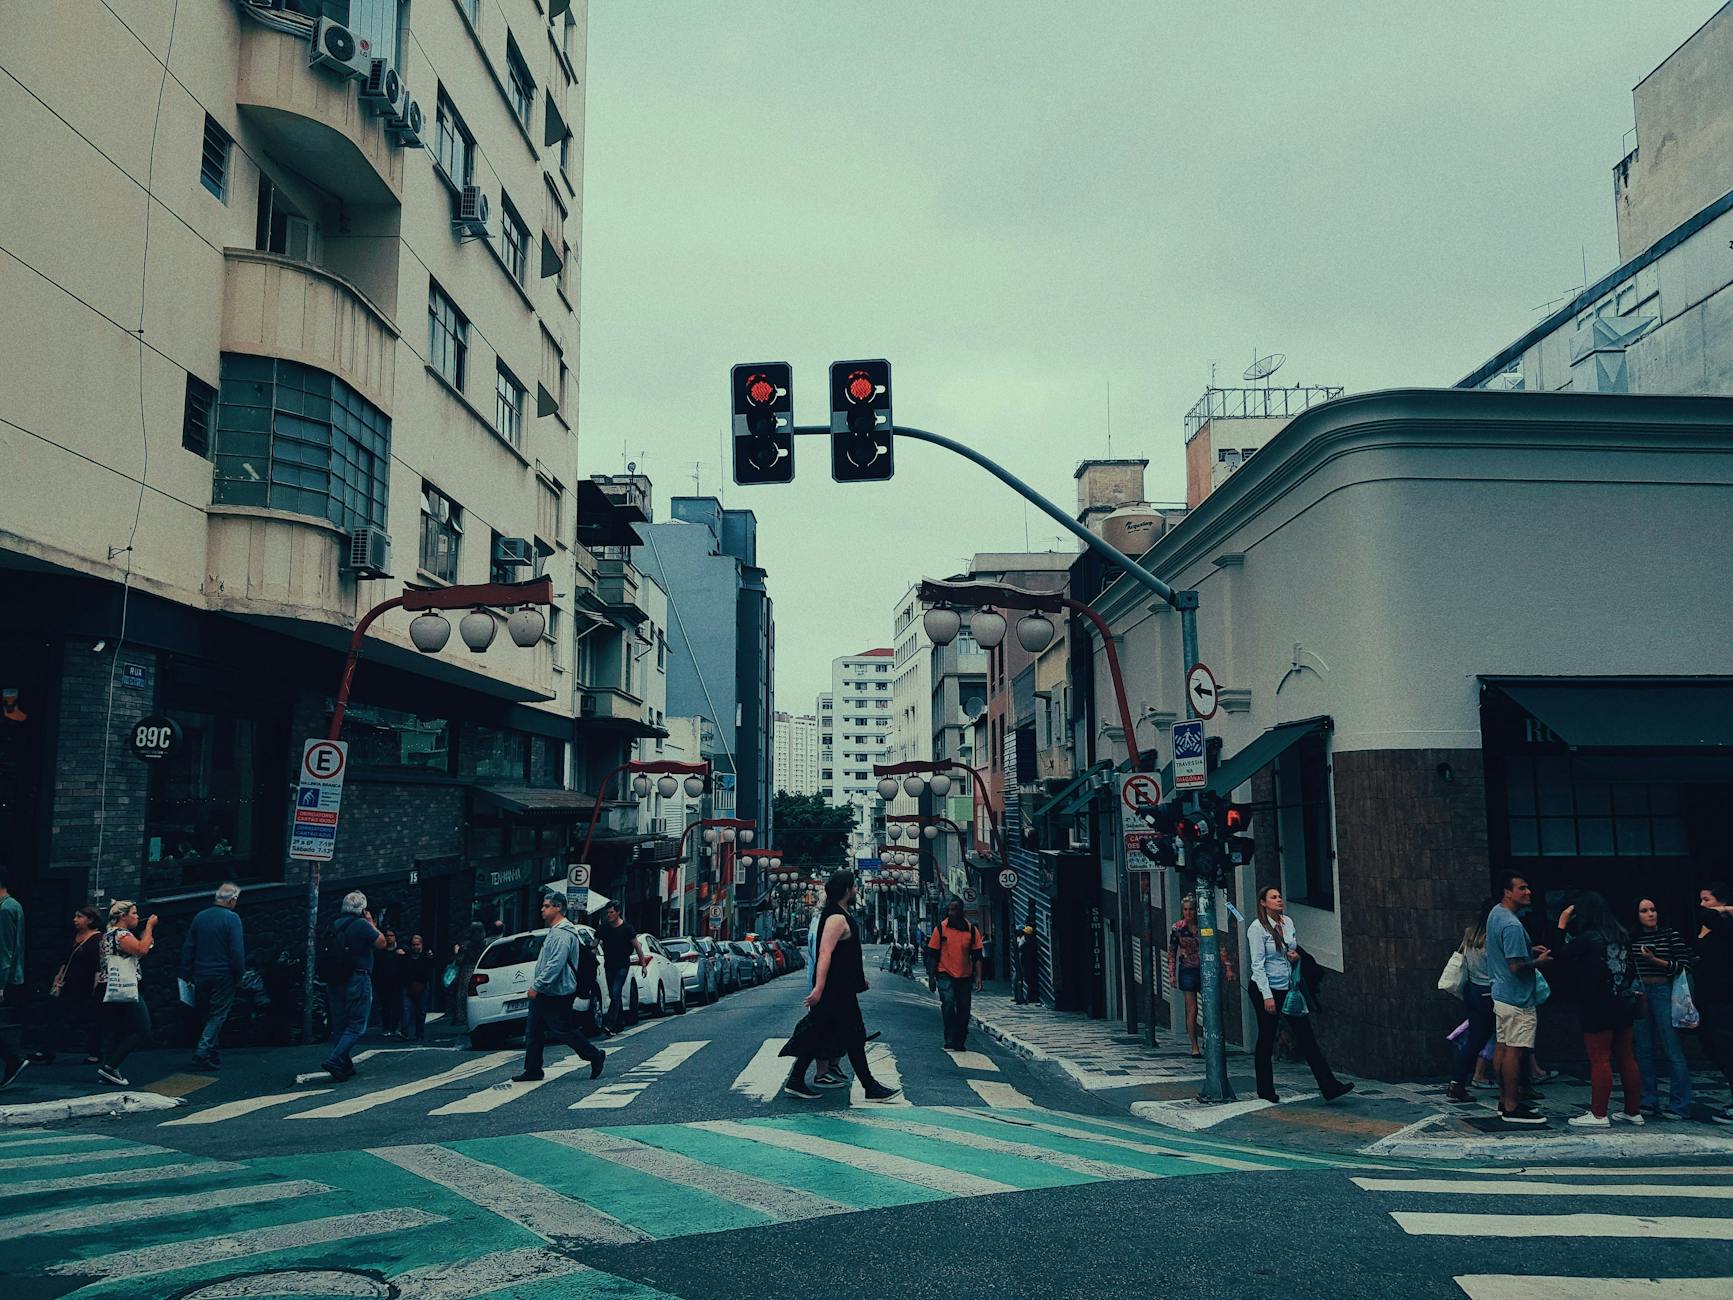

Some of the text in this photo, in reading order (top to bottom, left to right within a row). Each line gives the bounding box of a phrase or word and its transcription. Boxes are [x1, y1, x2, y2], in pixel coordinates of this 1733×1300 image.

[129, 667, 142, 677] RUA
[316, 750, 332, 771] E
[1176, 760, 1203, 768] TRAVESSIA
[575, 870, 583, 882] E
[1001, 873, 1016, 883] 30
